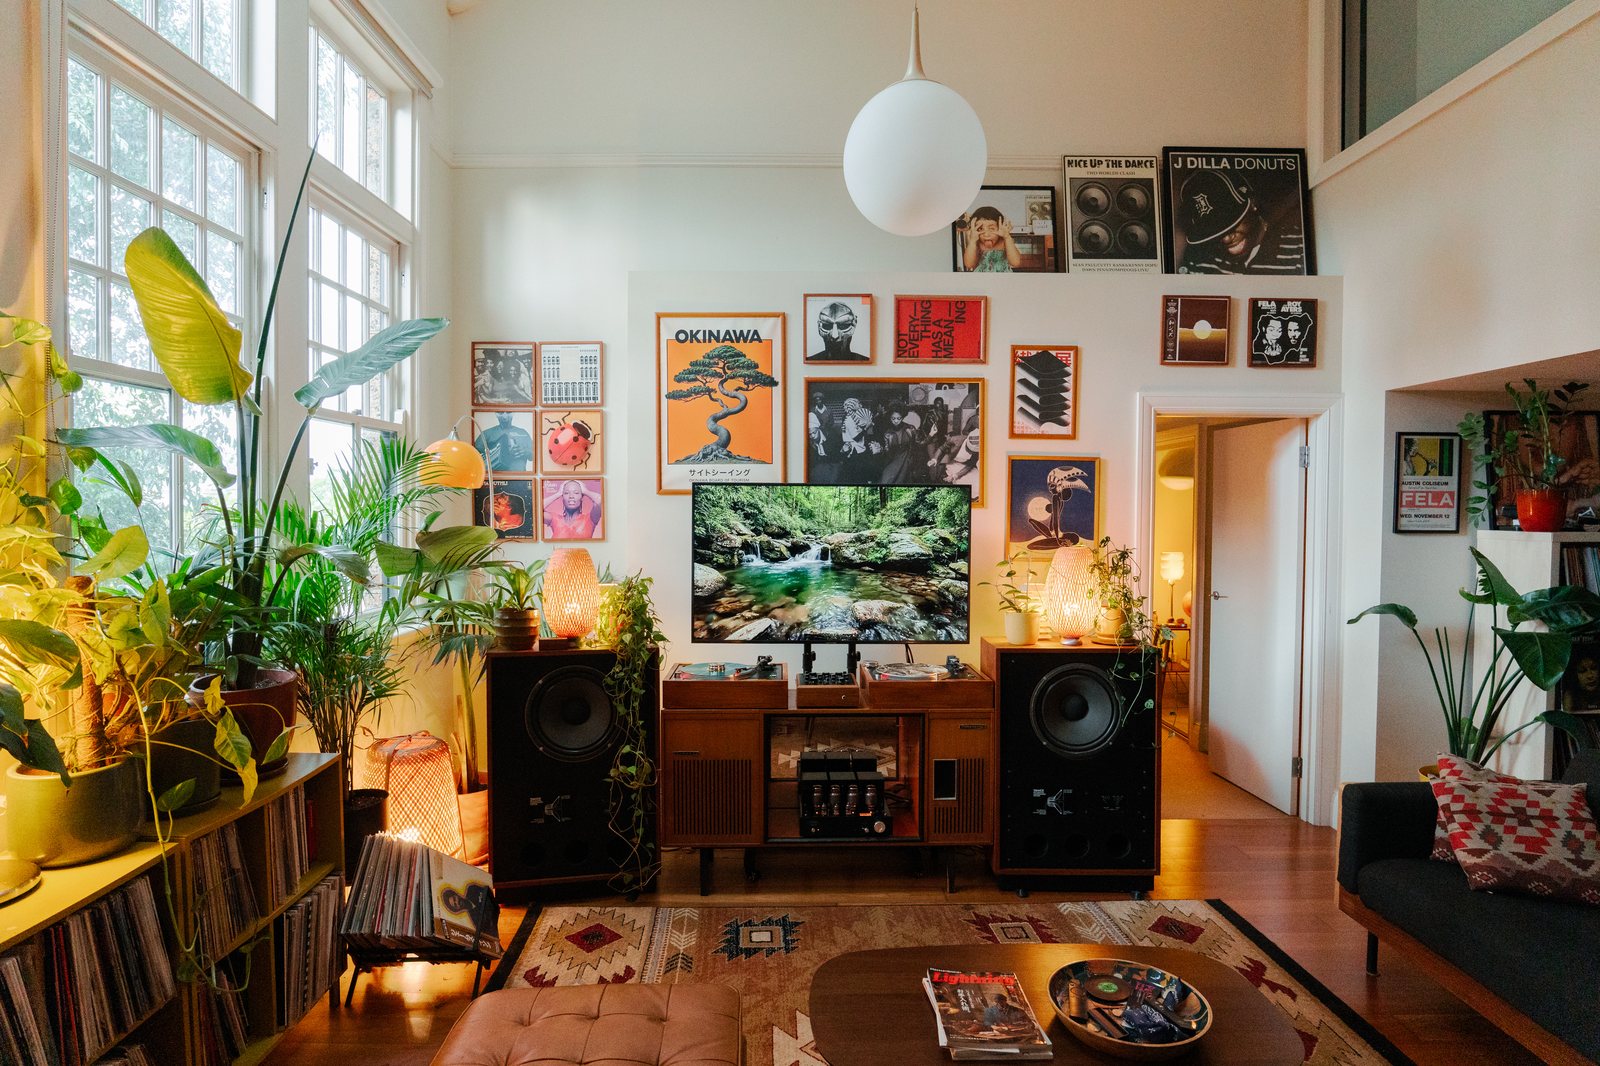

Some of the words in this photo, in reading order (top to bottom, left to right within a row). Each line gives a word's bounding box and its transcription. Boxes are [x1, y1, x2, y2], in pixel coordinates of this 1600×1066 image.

[1067, 159, 1088, 168] NICE
[1090, 158, 1103, 168] UP
[1105, 159, 1122, 168] THE
[1124, 159, 1154, 168] DANCE
[1173, 157, 1182, 169] J
[1187, 157, 1231, 169] DILLA
[1234, 158, 1296, 170] DONUTS
[954, 301, 966, 324] ING
[920, 300, 932, 340] THING
[932, 318, 943, 328] A
[675, 329, 763, 344] OKINAWA
[897, 331, 908, 358] NOT
[932, 331, 943, 359] HAS
[689, 468, 751, 477] サイトシーイング
[1402, 493, 1453, 506] FELA
[932, 972, 1015, 985] Lightning
